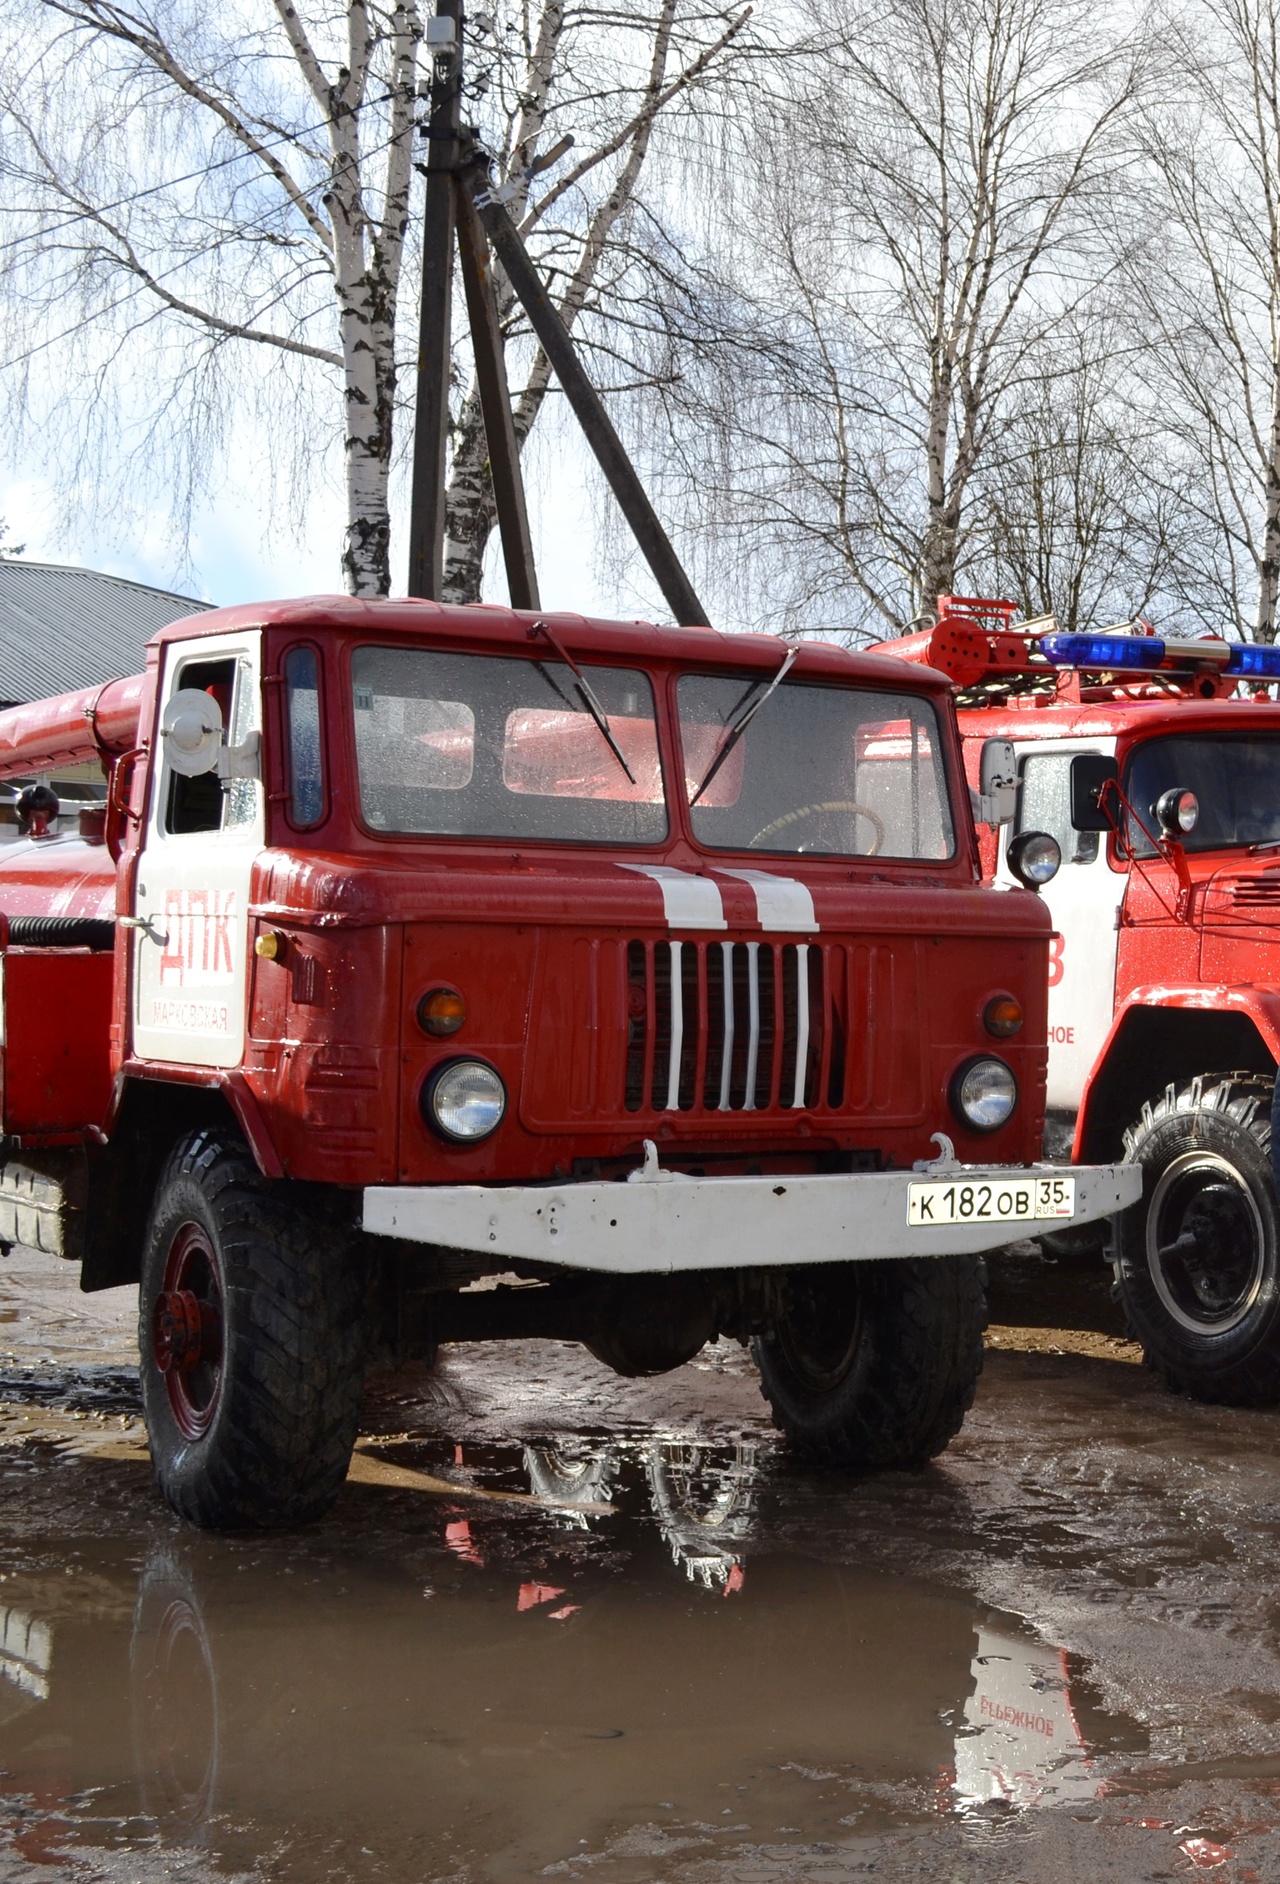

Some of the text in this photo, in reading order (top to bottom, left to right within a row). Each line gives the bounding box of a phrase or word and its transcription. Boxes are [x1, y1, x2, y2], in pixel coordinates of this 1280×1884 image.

[159, 889, 236, 987] ДПК
[153, 1001, 228, 1031] МАРКОВСКАЯ
[1040, 1181, 1064, 1204] 35
[1036, 1205, 1055, 1215] RUS
